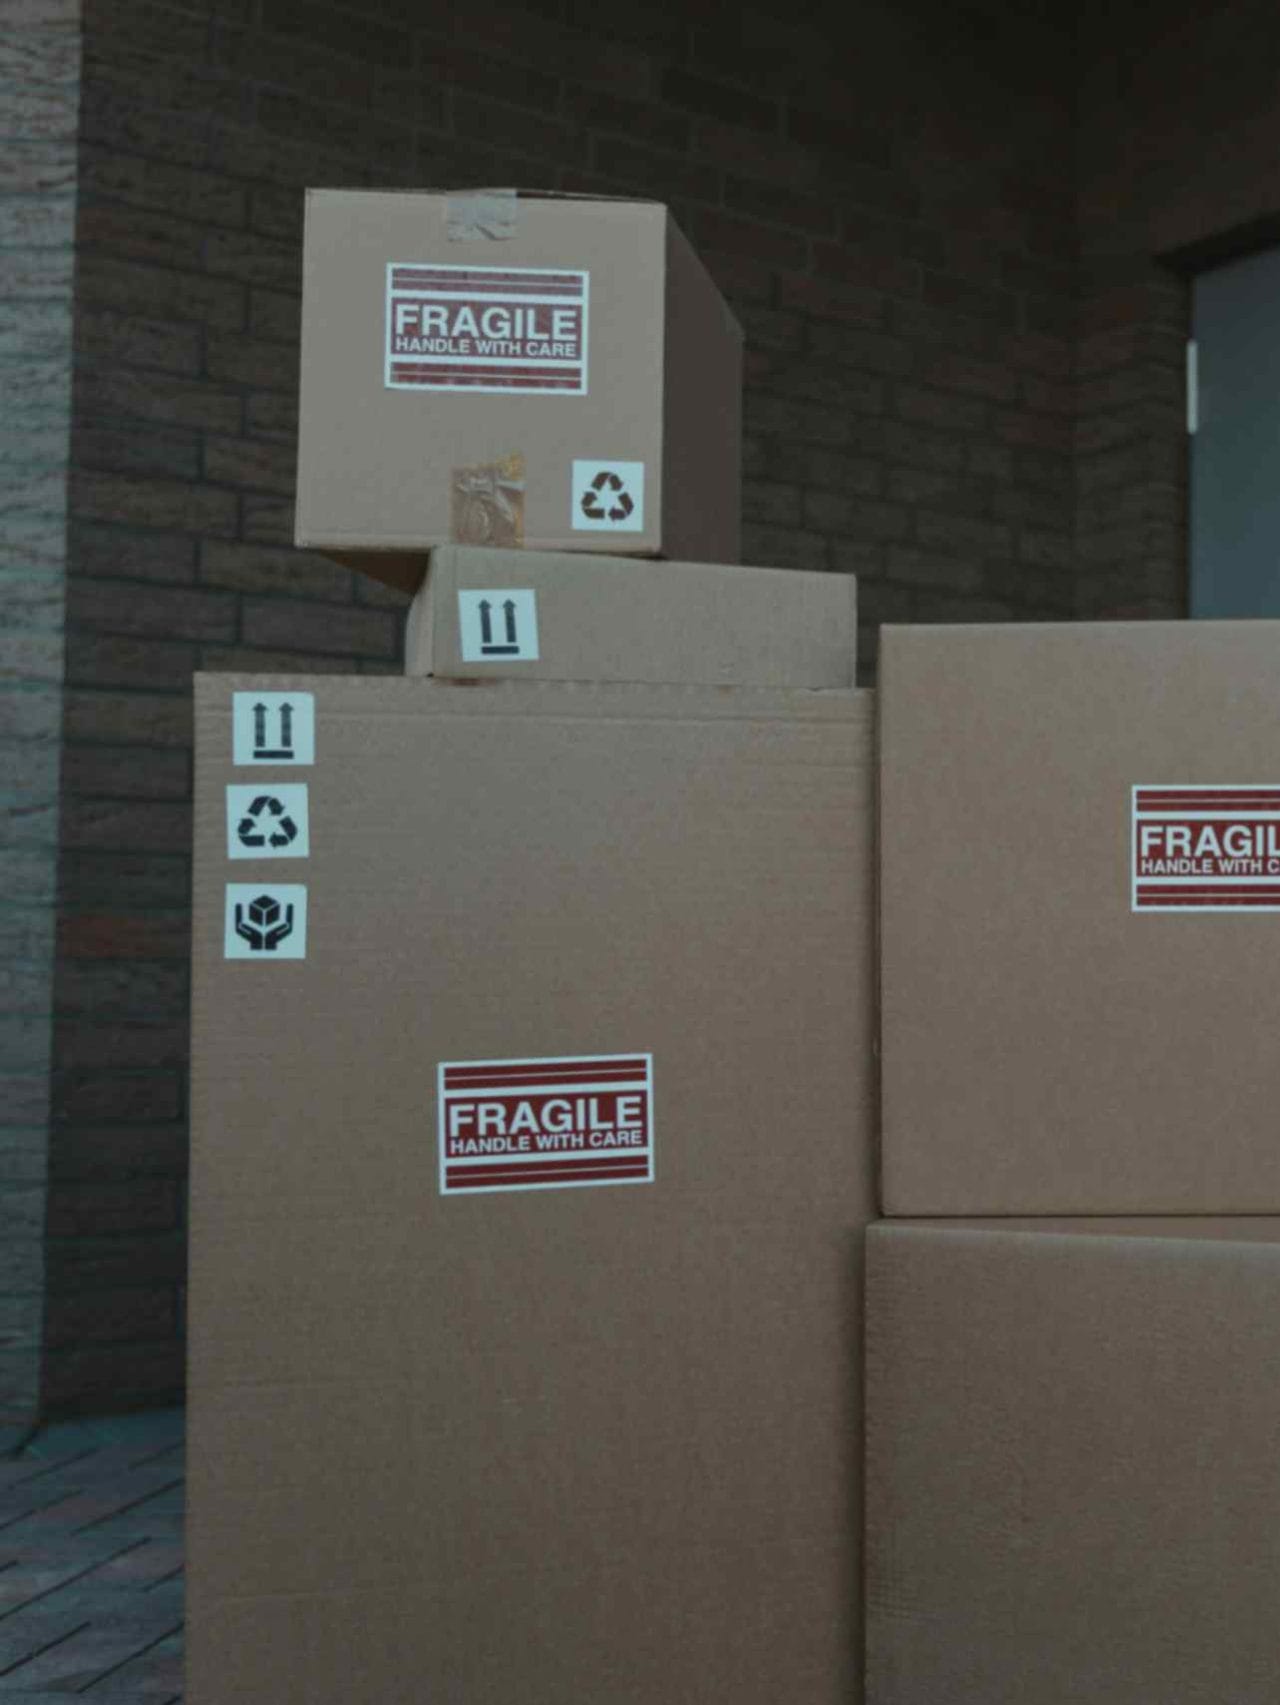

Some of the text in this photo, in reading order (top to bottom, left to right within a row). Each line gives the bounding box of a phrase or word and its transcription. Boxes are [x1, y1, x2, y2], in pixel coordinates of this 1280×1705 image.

[395, 303, 577, 341] FRAGILE
[395, 337, 576, 357] HANDLE WITH CARE
[1141, 859, 1213, 874] HANDLE
[1218, 859, 1262, 874] WITH
[449, 1096, 643, 1137] FRAGILE
[450, 1130, 643, 1155] HANDLE WITH CARE
